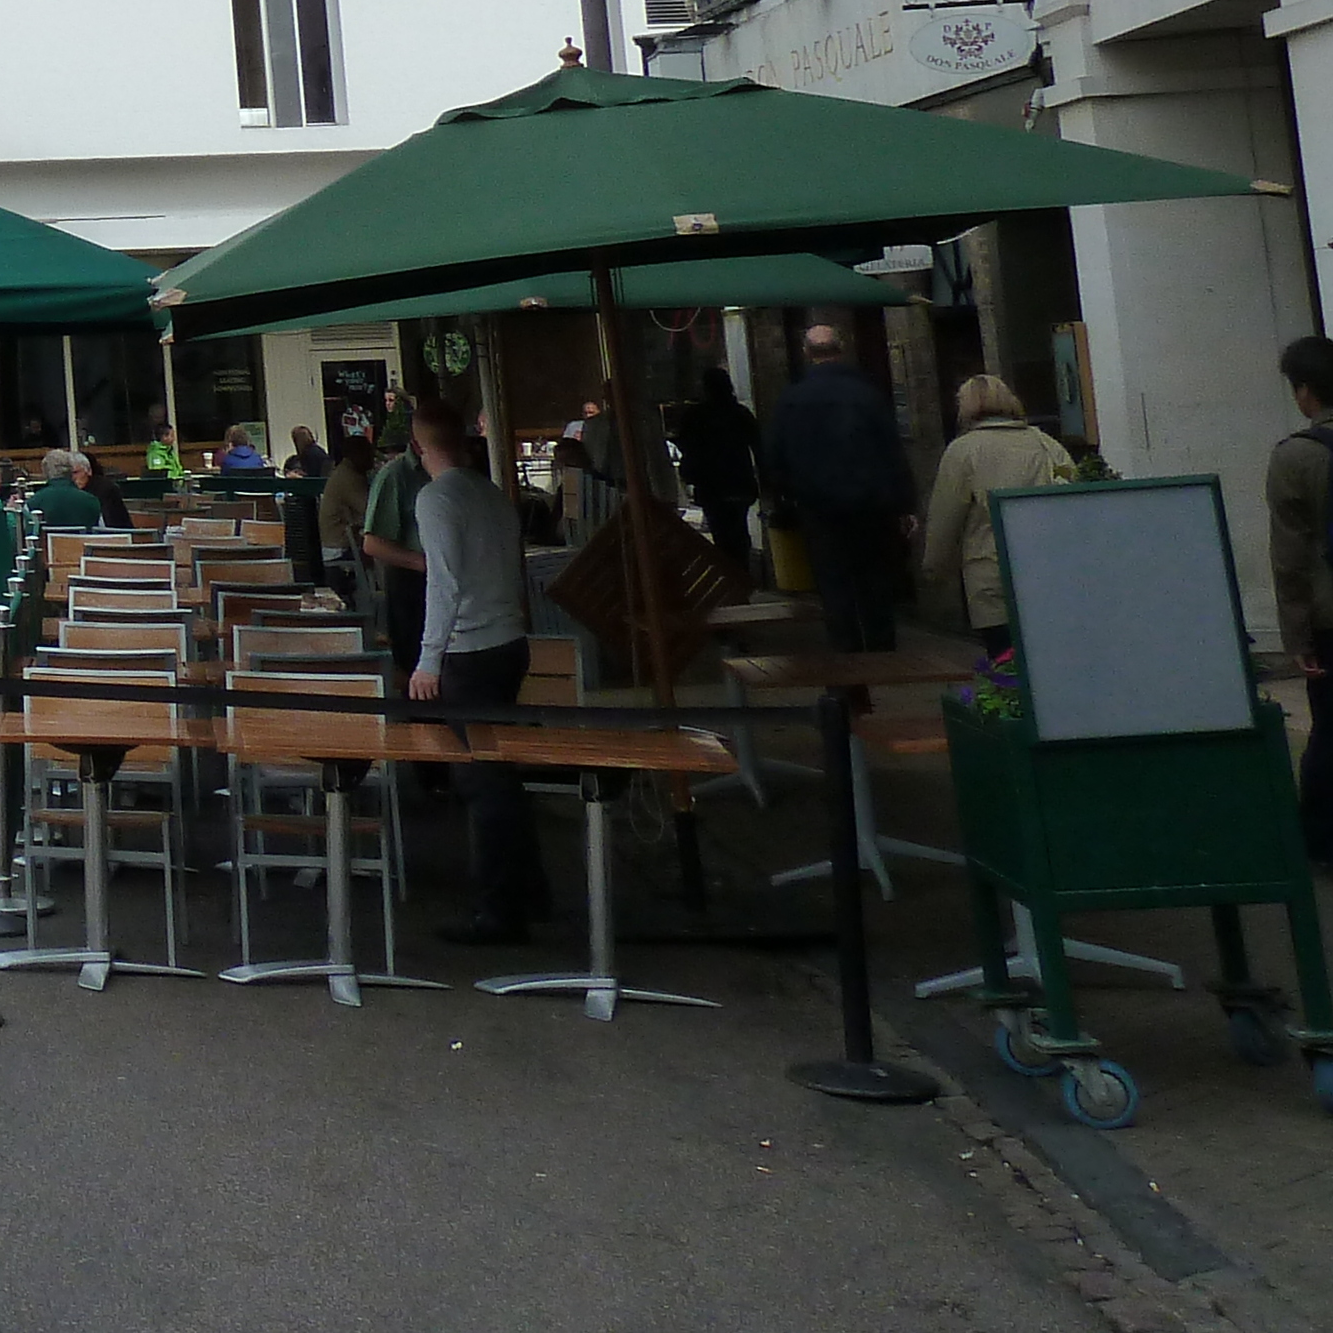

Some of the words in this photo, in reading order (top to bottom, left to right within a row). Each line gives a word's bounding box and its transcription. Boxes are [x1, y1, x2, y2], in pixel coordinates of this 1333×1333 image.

[791, 11, 894, 88] PASQUALE
[926, 54, 954, 69] DON
[955, 48, 1016, 70] PASQUALE
